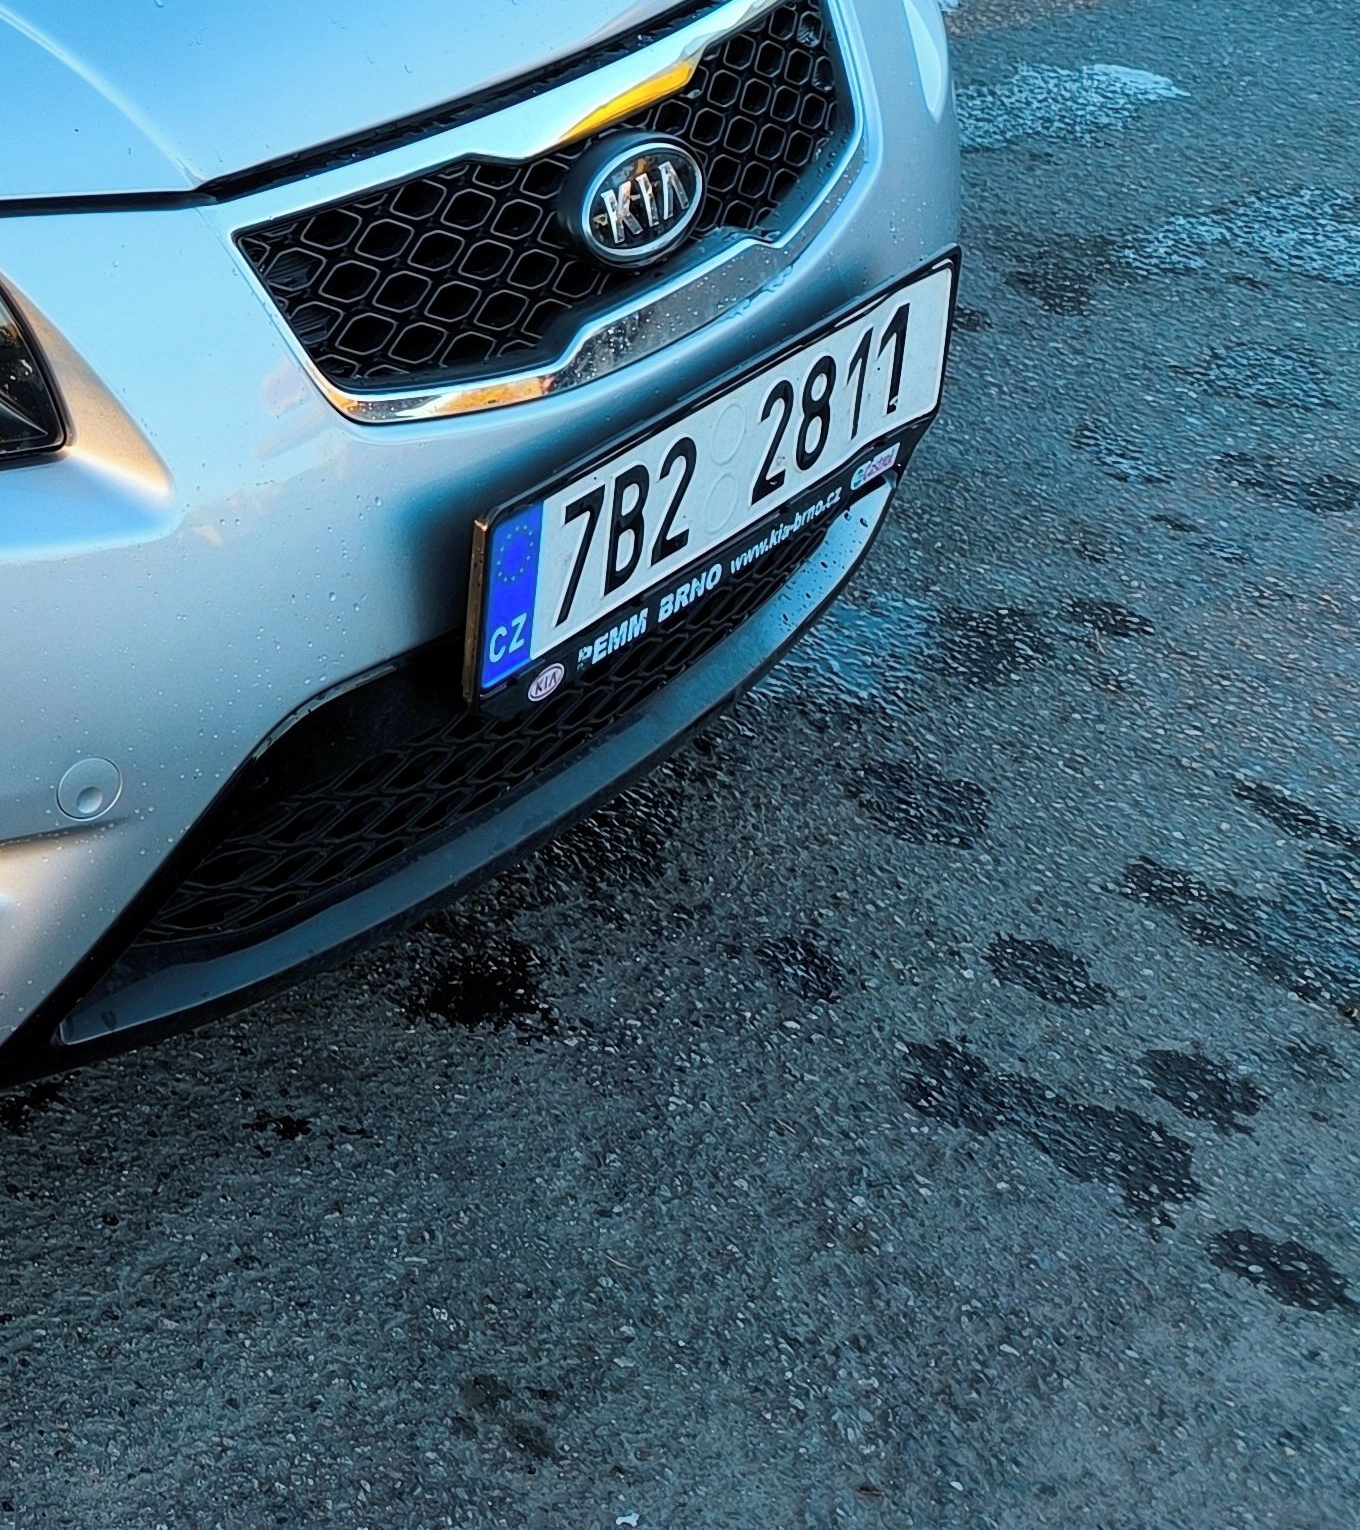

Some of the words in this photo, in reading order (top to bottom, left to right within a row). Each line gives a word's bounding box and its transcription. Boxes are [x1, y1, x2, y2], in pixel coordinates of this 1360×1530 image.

[600, 160, 690, 245] KIA
[555, 436, 698, 628] 7B2
[751, 301, 911, 507] 2811
[657, 563, 723, 624] BRNO
[730, 486, 843, 575] www.kia-brno.cz
[488, 612, 528, 663] CZ
[534, 671, 558, 696] KIA
